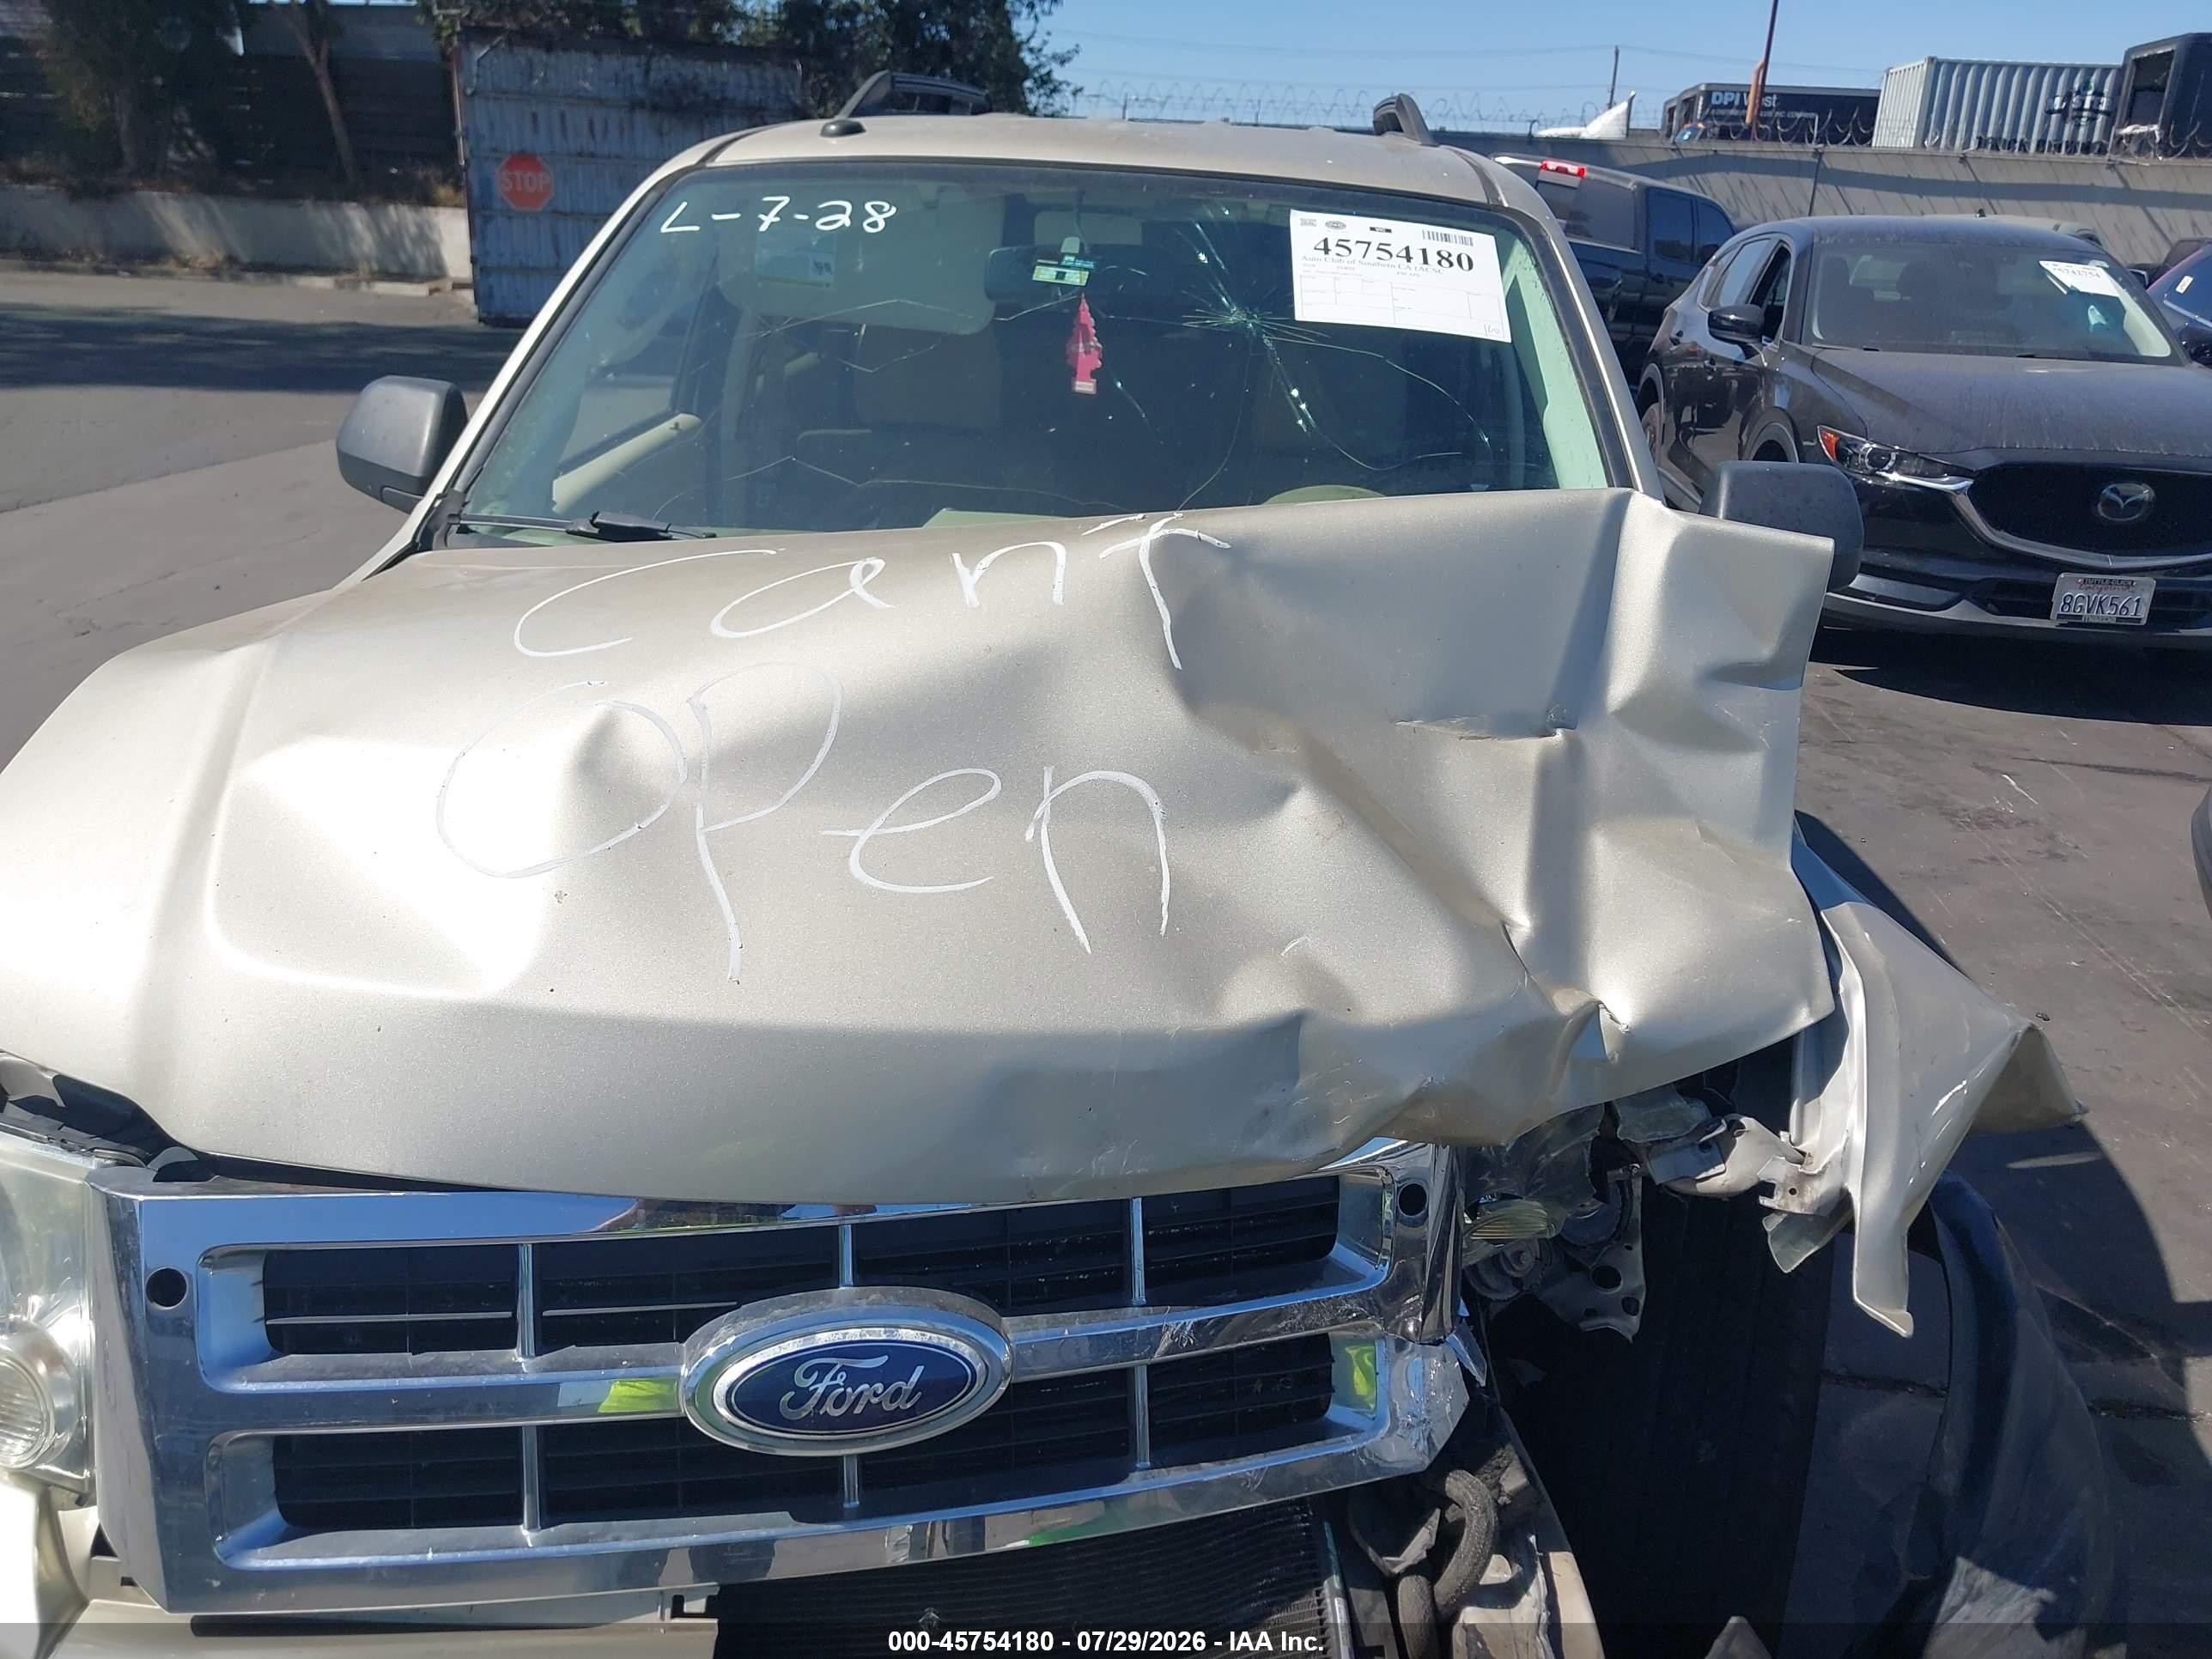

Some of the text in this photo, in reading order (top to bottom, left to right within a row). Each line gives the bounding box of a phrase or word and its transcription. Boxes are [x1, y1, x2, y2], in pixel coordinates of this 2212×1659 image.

[1711, 91, 1741, 105] DPI
[500, 170, 551, 193] STOP
[1313, 235, 1474, 272] 45754180
[2060, 592, 2144, 617] 8GVK561
[779, 1354, 925, 1420] Ford
